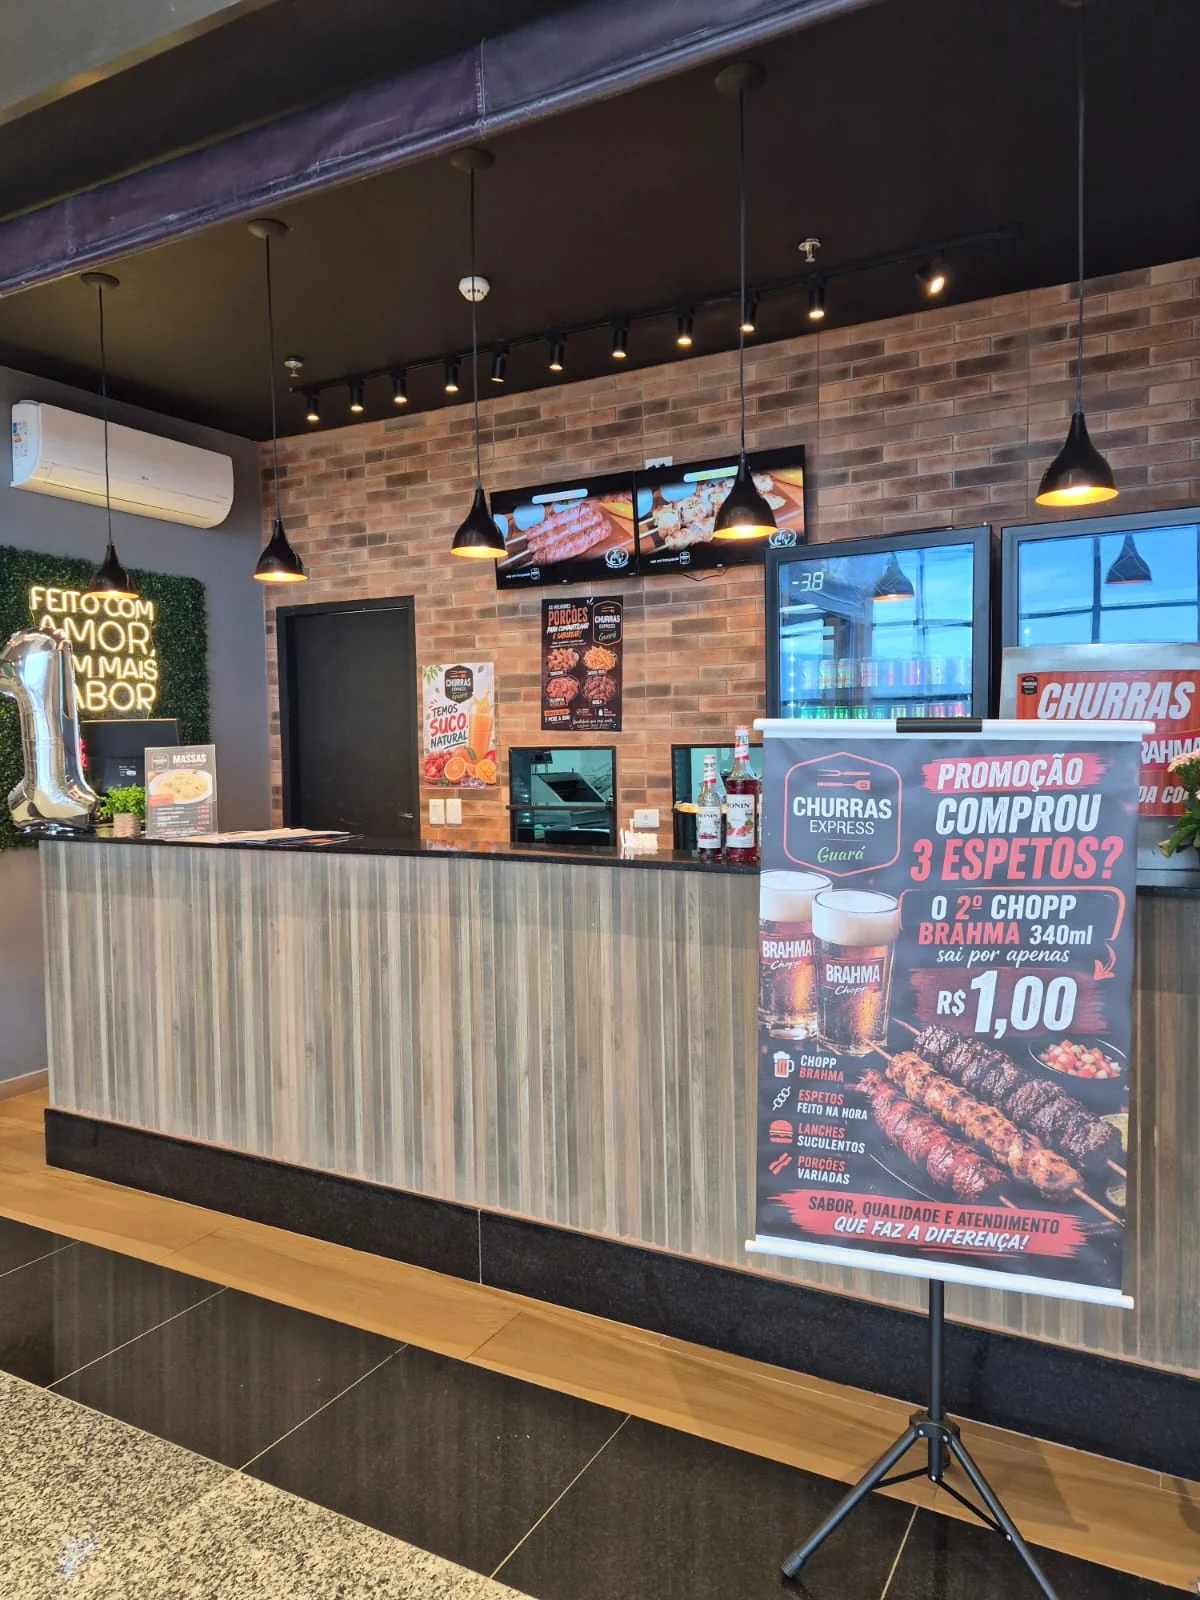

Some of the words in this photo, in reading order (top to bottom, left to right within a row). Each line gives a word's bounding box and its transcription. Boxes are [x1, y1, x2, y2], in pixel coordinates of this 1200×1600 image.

[30, 586, 99, 615] FEITO
[104, 597, 154, 621] COM
[99, 656, 158, 681] MAIS
[431, 703, 458, 718] TEMOS
[1036, 681, 1196, 720] CHURRAS
[429, 712, 467, 738] SUCO
[430, 730, 468, 749] NATURAL
[172, 753, 207, 765] MASSAS
[937, 753, 1084, 792] PROMOÇÃO
[792, 796, 893, 819] CHURRAS
[935, 794, 1101, 835] COMPROU
[809, 820, 875, 835] EXPRESS
[816, 845, 865, 863] Guará
[910, 838, 934, 881] 3
[941, 836, 1124, 880] ESPETOS?
[931, 895, 948, 920] O
[955, 895, 983, 920] 2º
[990, 894, 1077, 920] CHOPP
[918, 922, 1020, 945] BRAHMA
[1029, 925, 1093, 946] 340ml
[762, 938, 812, 959] BRAHMA
[936, 947, 964, 963] sai
[966, 949, 1000, 968] por
[1006, 949, 1070, 968] apenas
[826, 963, 880, 984] BRAHMA
[936, 989, 967, 1017] R$
[970, 970, 1078, 1039] 1,00
[800, 1054, 837, 1069] CHOPP
[799, 1067, 844, 1083] BRAHMA
[798, 1089, 844, 1105] ESPETOS
[797, 1102, 823, 1115] FEITO
[825, 1105, 839, 1118] NA
[842, 1107, 868, 1120] HORA
[798, 1122, 845, 1139] LANCHES
[797, 1135, 866, 1154] SUCULENTOS
[797, 1155, 846, 1172] PORÇÕES
[797, 1167, 850, 1185] VARIADAS
[808, 1195, 857, 1217] SABOR,
[862, 1201, 941, 1224] QUALIDADE
[944, 1210, 954, 1225] E
[956, 1211, 1060, 1235] ATENDIMENTO
[833, 1215, 869, 1234] QUE
[870, 1220, 905, 1238] FAZ
[907, 1224, 920, 1241] A
[924, 1226, 1030, 1252] DIFERENÇA!
